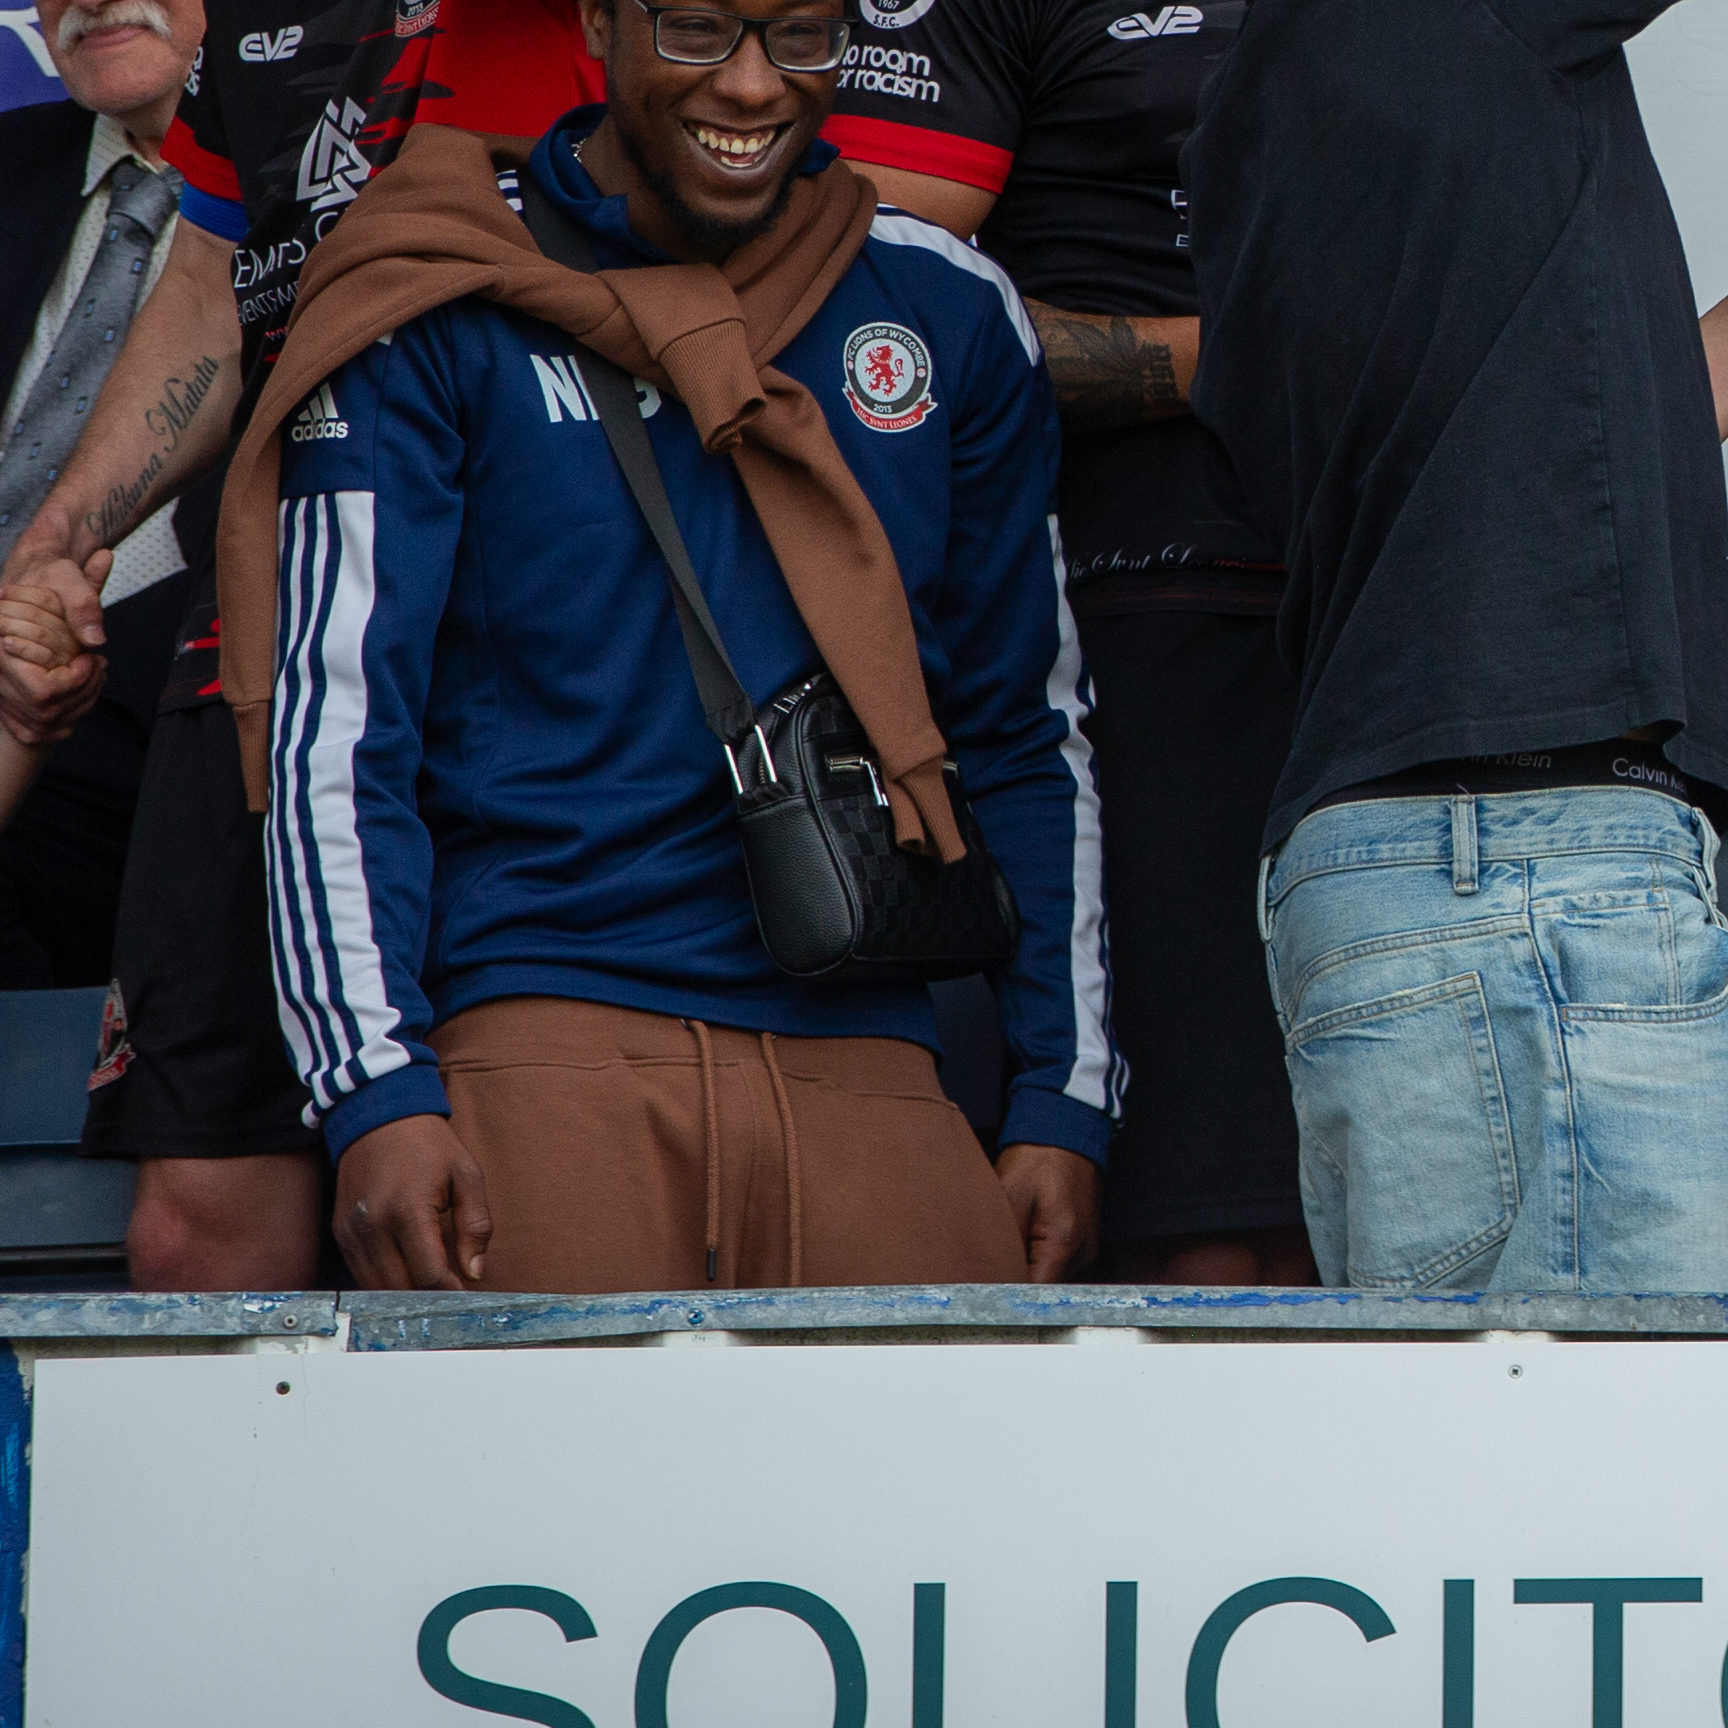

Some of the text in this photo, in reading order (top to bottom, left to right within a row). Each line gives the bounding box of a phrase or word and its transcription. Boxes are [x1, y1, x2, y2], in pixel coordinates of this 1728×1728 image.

[873, 14, 899, 27] S.F.C.
[861, 45, 930, 76] room
[836, 69, 941, 103] or racism
[851, 330, 874, 350] LIONS
[874, 328, 888, 337] OF
[889, 329, 925, 367] WYCOMBE
[873, 403, 892, 413] 2013
[291, 418, 349, 442] adidas
[86, 355, 219, 537] Hakuna Matata
[1612, 757, 1668, 786] Calvin
